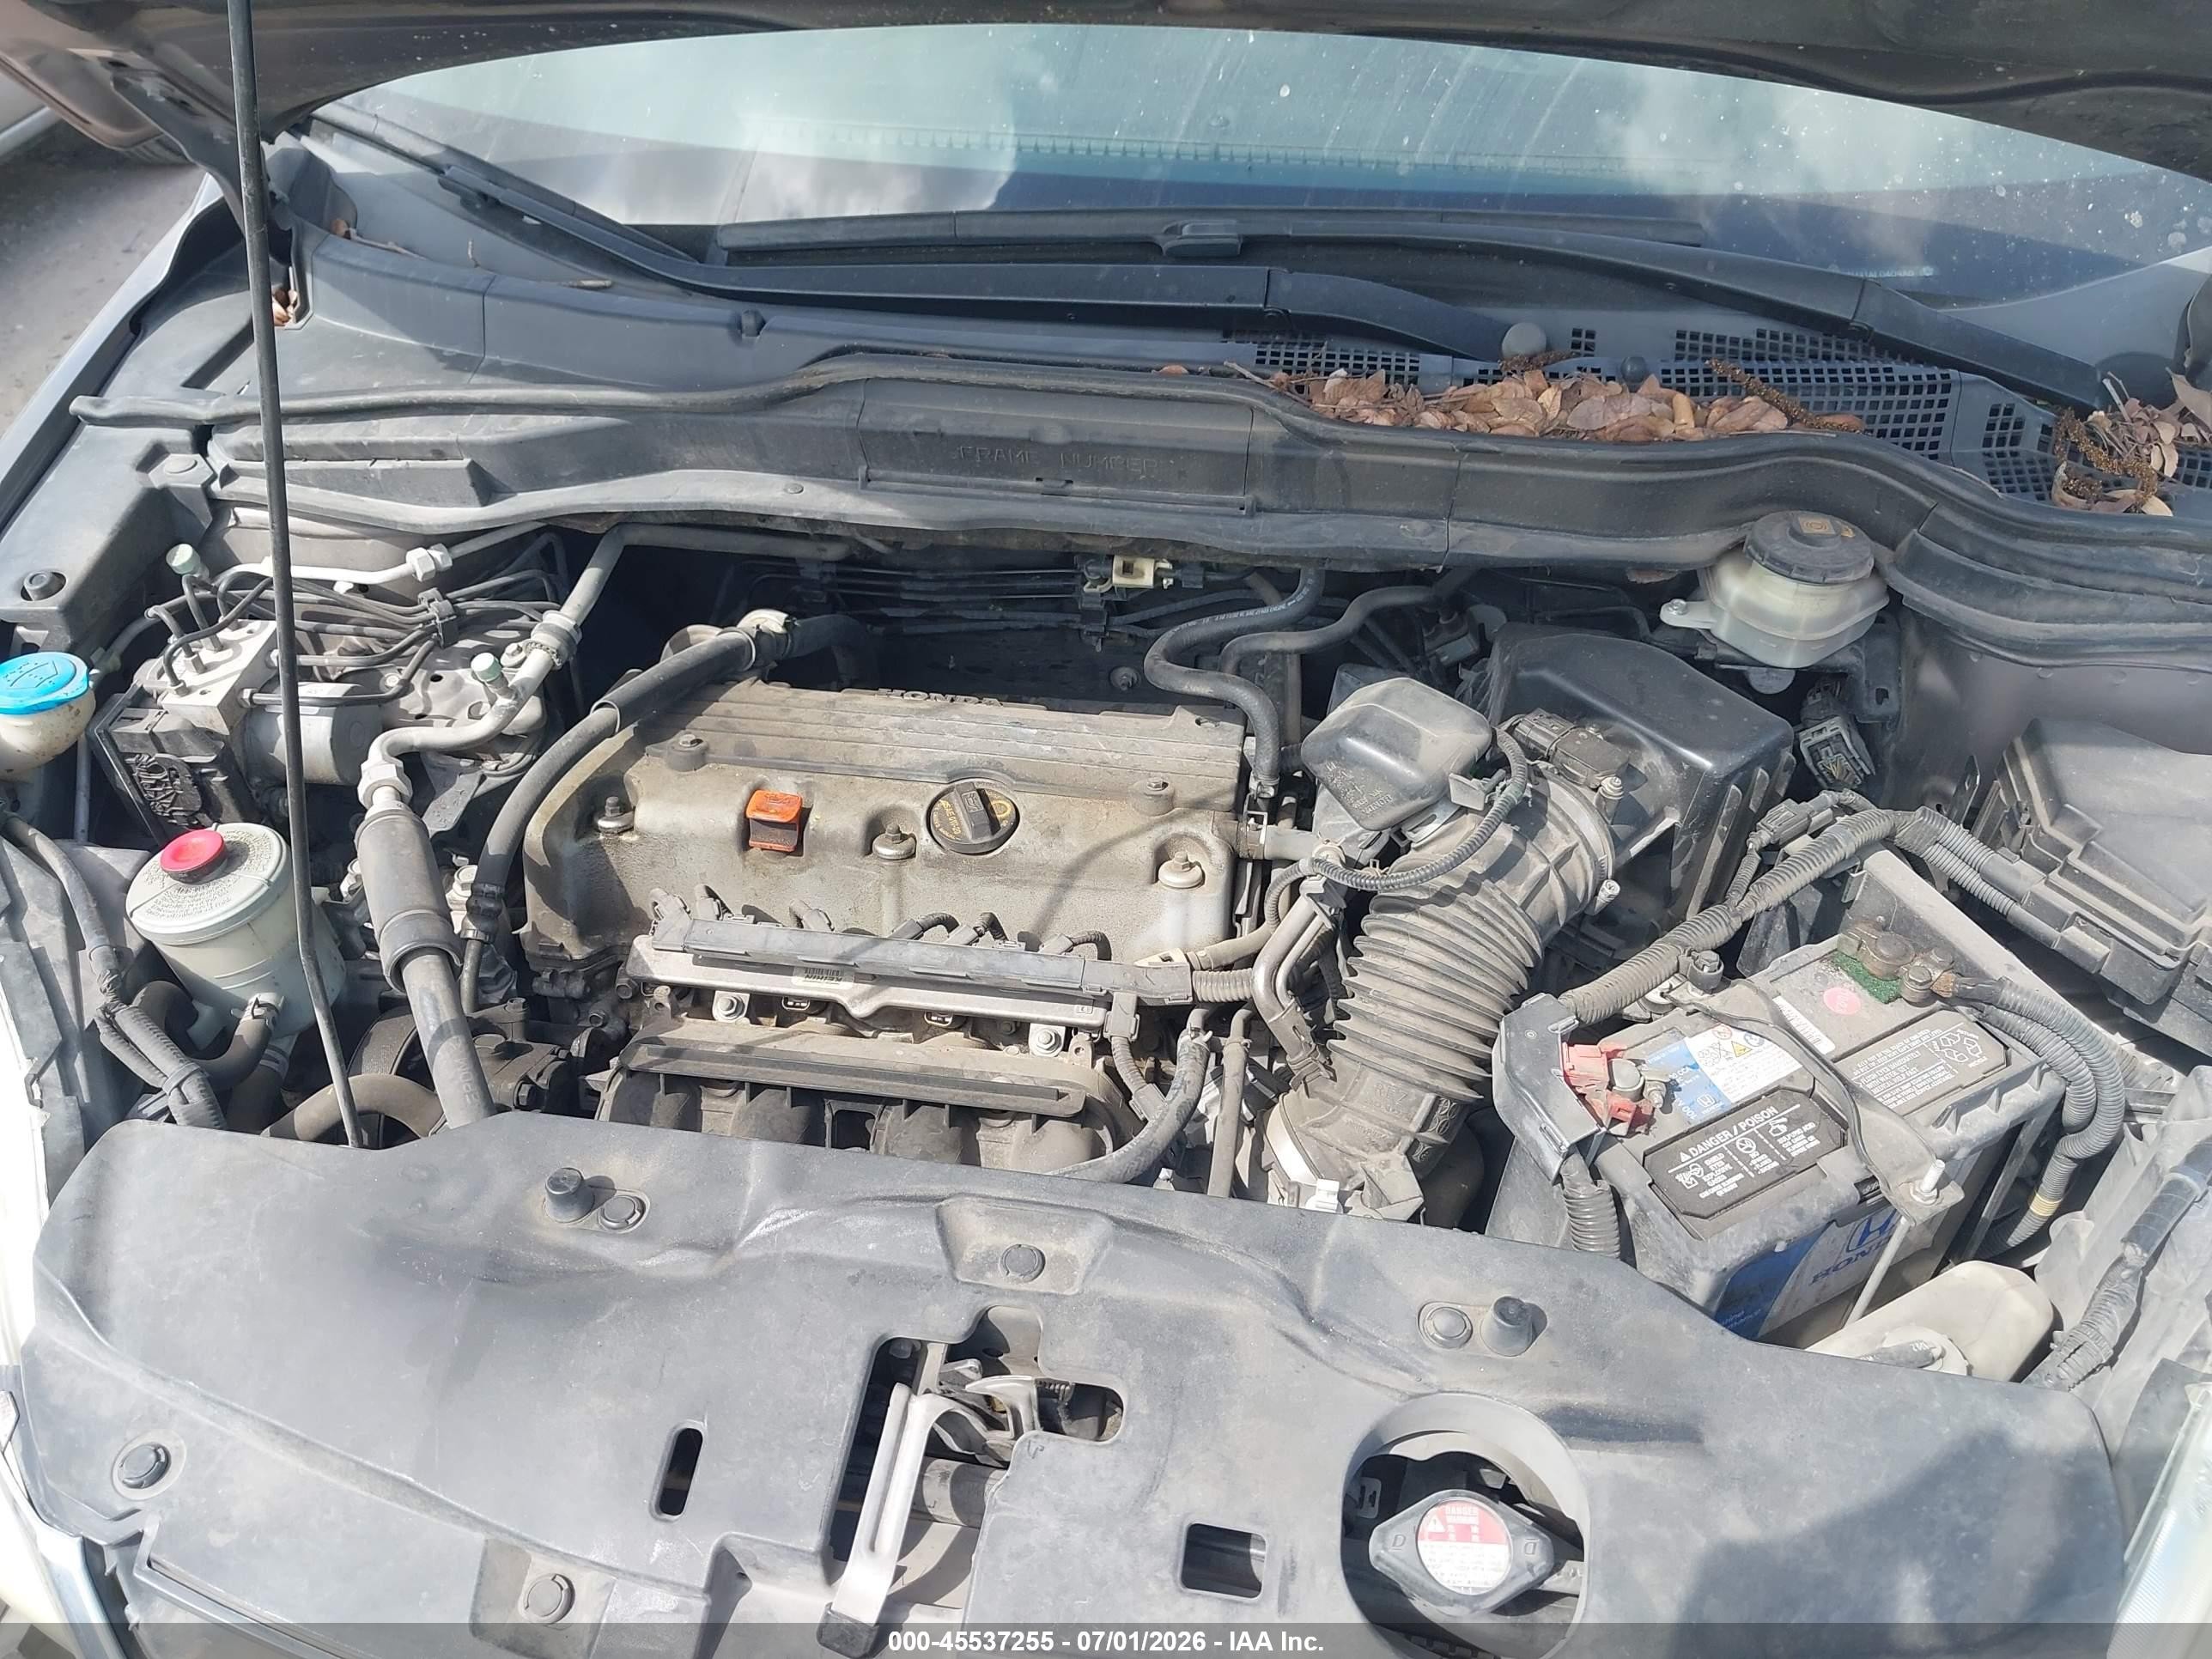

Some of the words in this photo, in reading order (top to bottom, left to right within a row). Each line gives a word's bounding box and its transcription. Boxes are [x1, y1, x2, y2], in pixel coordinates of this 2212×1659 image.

[878, 688, 1003, 708] HONDA
[804, 974, 843, 982] KEIHIN
[1689, 1130, 1732, 1157] DANGER
[1738, 1106, 1779, 1131] POISON
